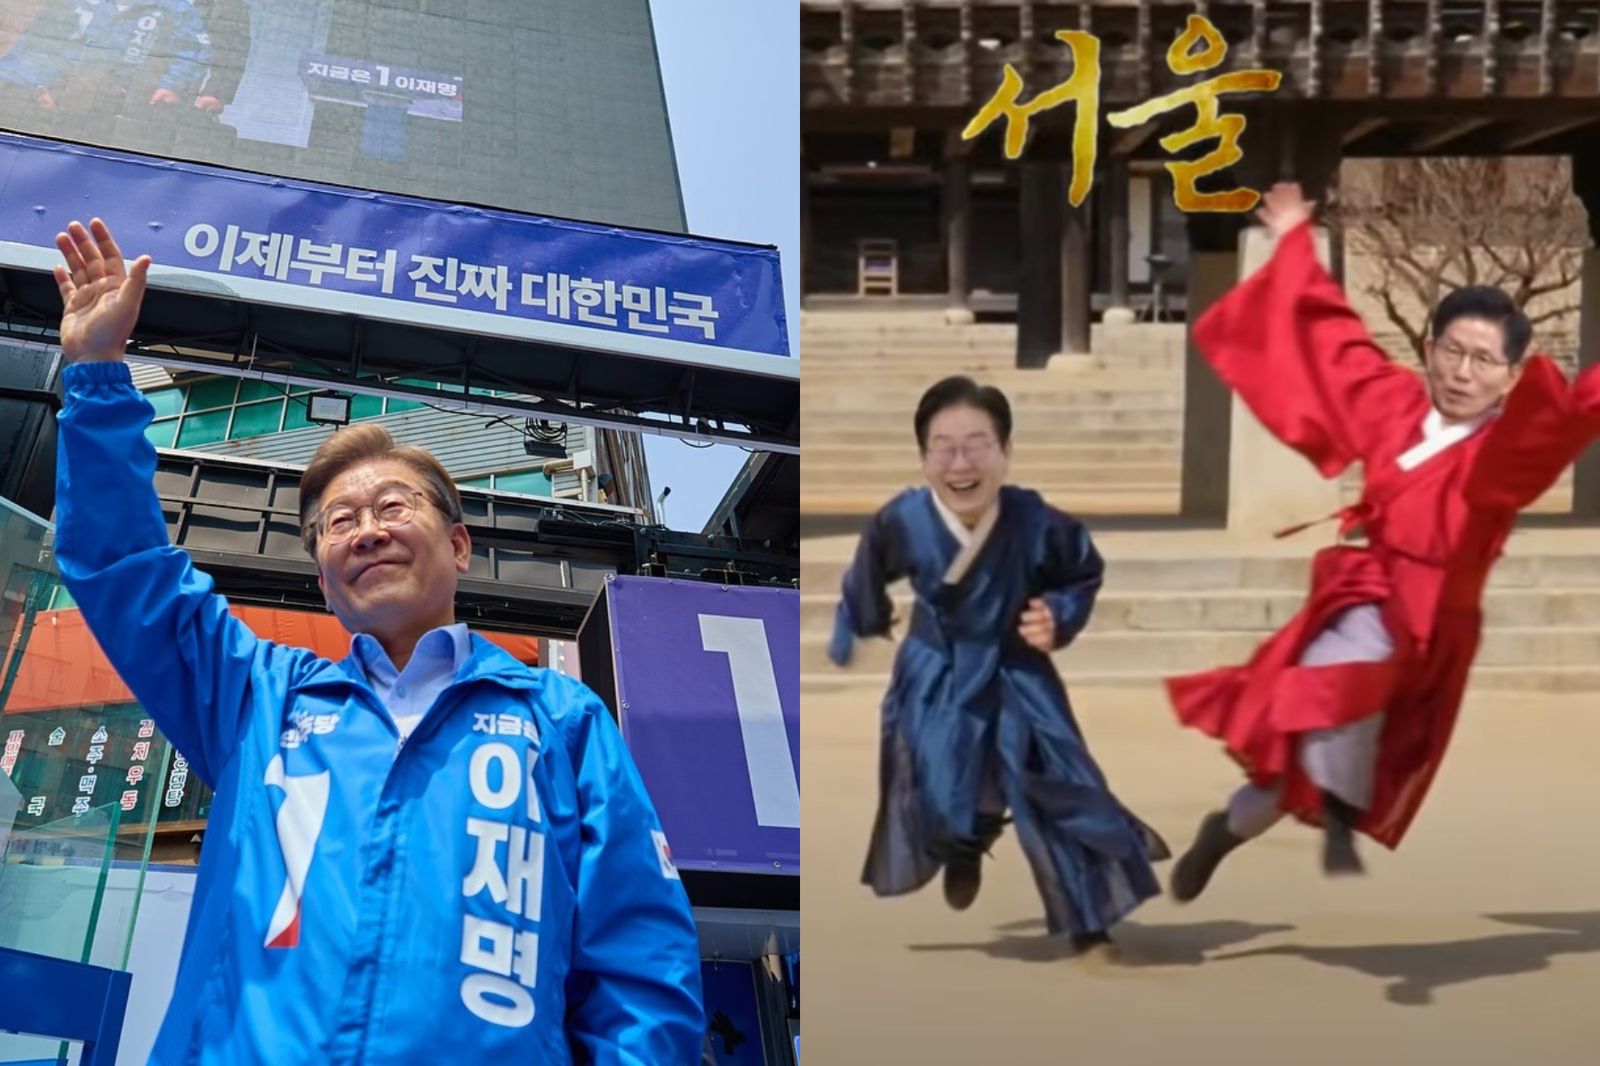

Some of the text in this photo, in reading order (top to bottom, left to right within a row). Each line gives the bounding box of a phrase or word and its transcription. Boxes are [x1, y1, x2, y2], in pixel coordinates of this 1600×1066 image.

[307, 62, 458, 97] 지금은 1 이재명
[184, 223, 719, 340] 이제부터 진짜 대한민국
[120, 719, 155, 811] 김치우동
[697, 613, 800, 829] 1
[461, 742, 545, 1028] 이재명
